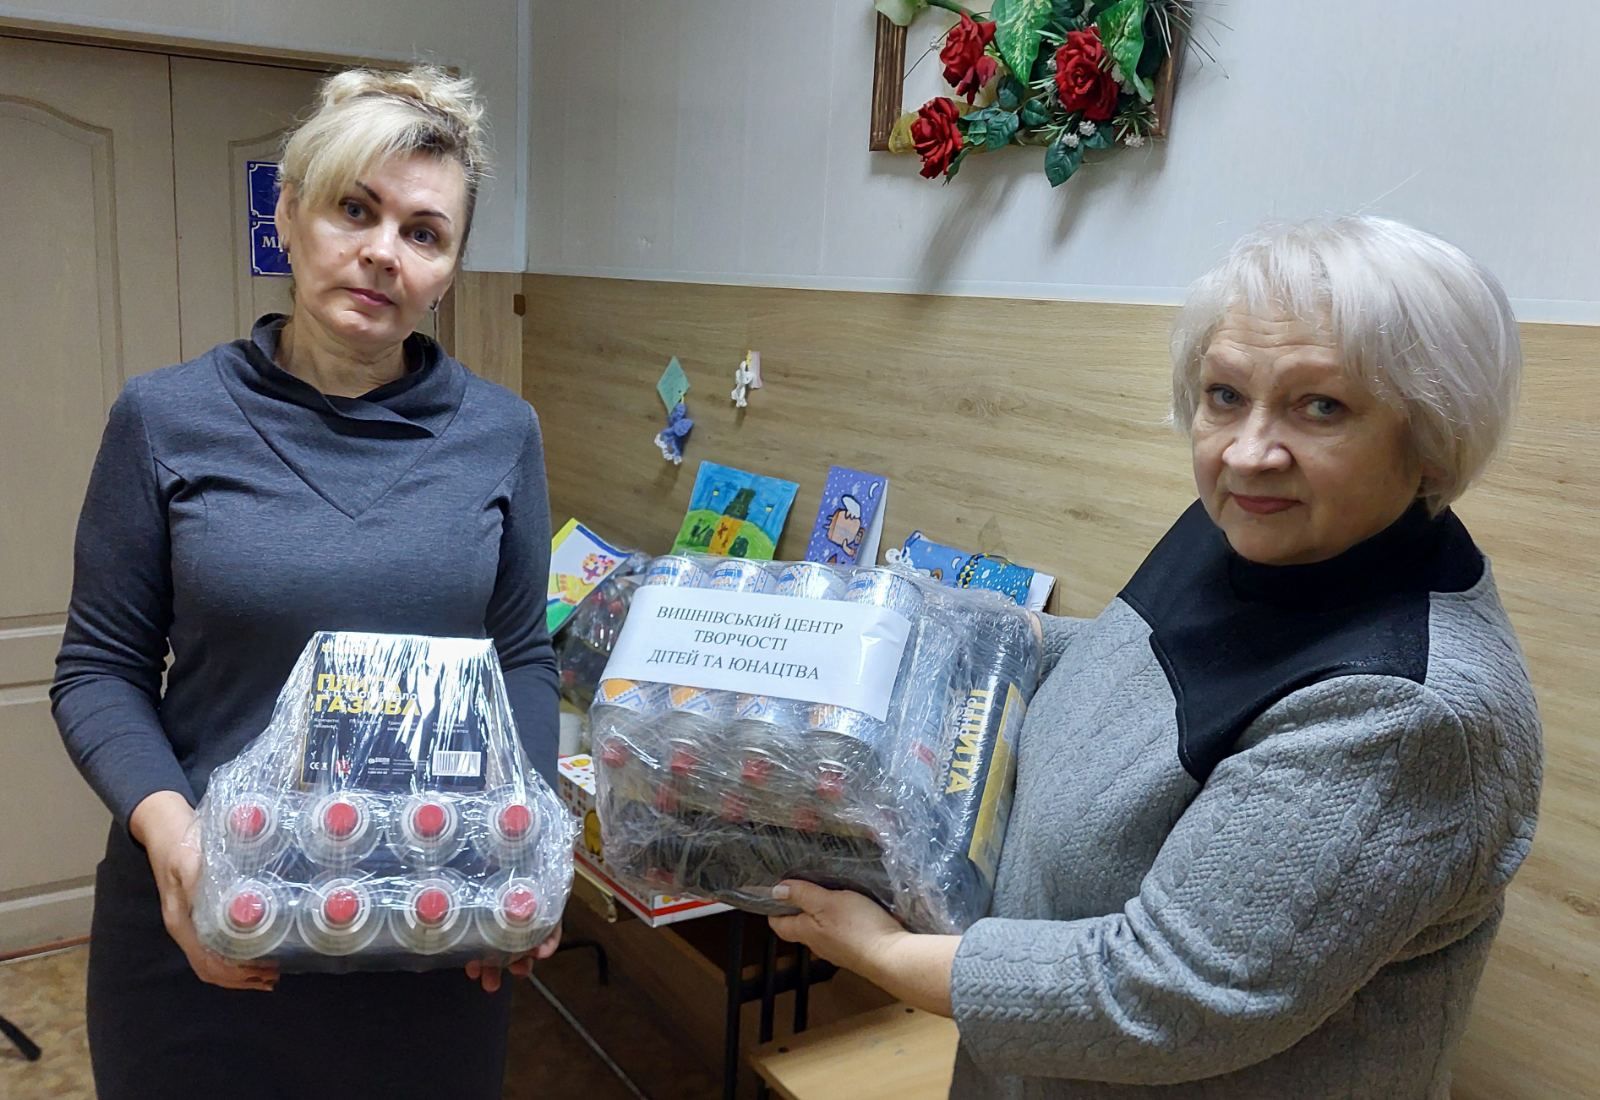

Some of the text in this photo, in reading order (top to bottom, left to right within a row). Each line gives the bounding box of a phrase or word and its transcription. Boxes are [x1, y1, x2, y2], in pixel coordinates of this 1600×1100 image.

[656, 606, 844, 635] ВИШНІВСЬКИЙ ЦЕНТР
[694, 629, 788, 651] ТВОРЧОСТІ
[646, 648, 819, 680] ДІТЕЙ ТА ЮНАЦТВА
[945, 689, 993, 794] ПЛИТА
